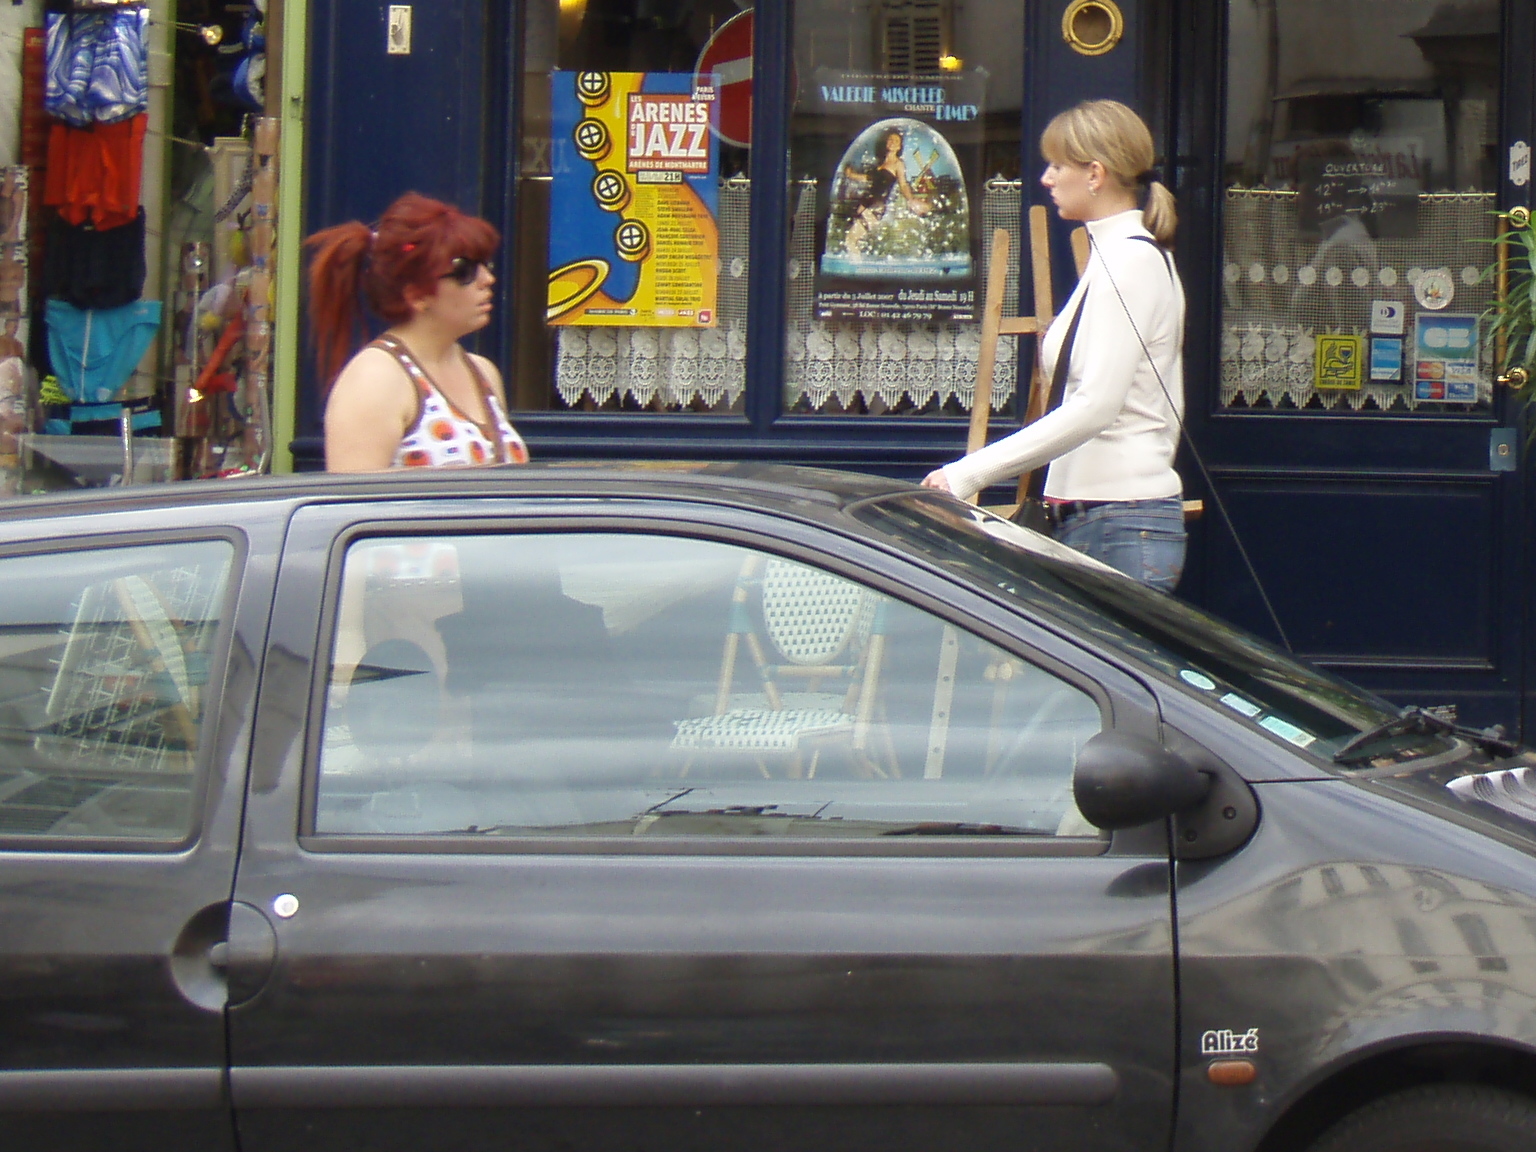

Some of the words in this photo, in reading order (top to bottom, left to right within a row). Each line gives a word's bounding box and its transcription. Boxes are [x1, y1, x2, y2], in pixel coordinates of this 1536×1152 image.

[821, 85, 877, 103] VALERIE
[630, 102, 708, 123] ARENES
[935, 104, 979, 121] DIMEY
[629, 123, 707, 157] JAZZ
[1201, 1027, 1259, 1054] Alizé
